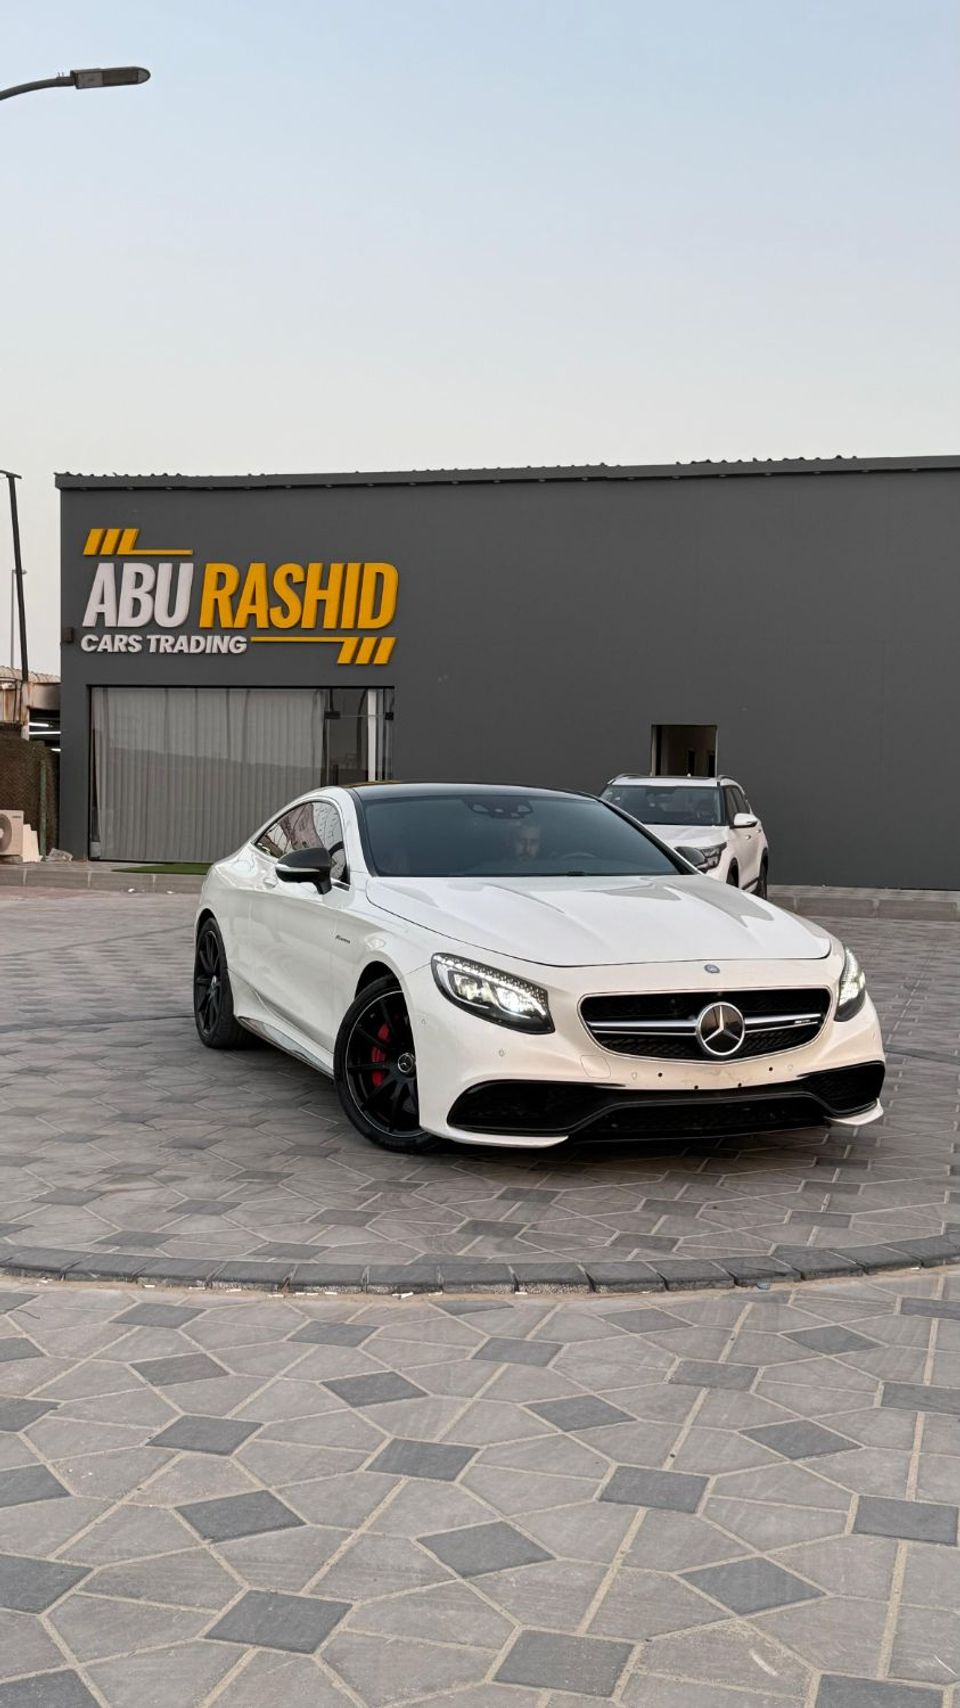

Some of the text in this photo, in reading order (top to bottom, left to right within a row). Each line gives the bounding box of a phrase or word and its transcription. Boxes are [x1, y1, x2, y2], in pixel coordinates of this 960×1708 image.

[82, 562, 399, 629] ABU RASHID
[80, 634, 248, 654] CARS TRADING
